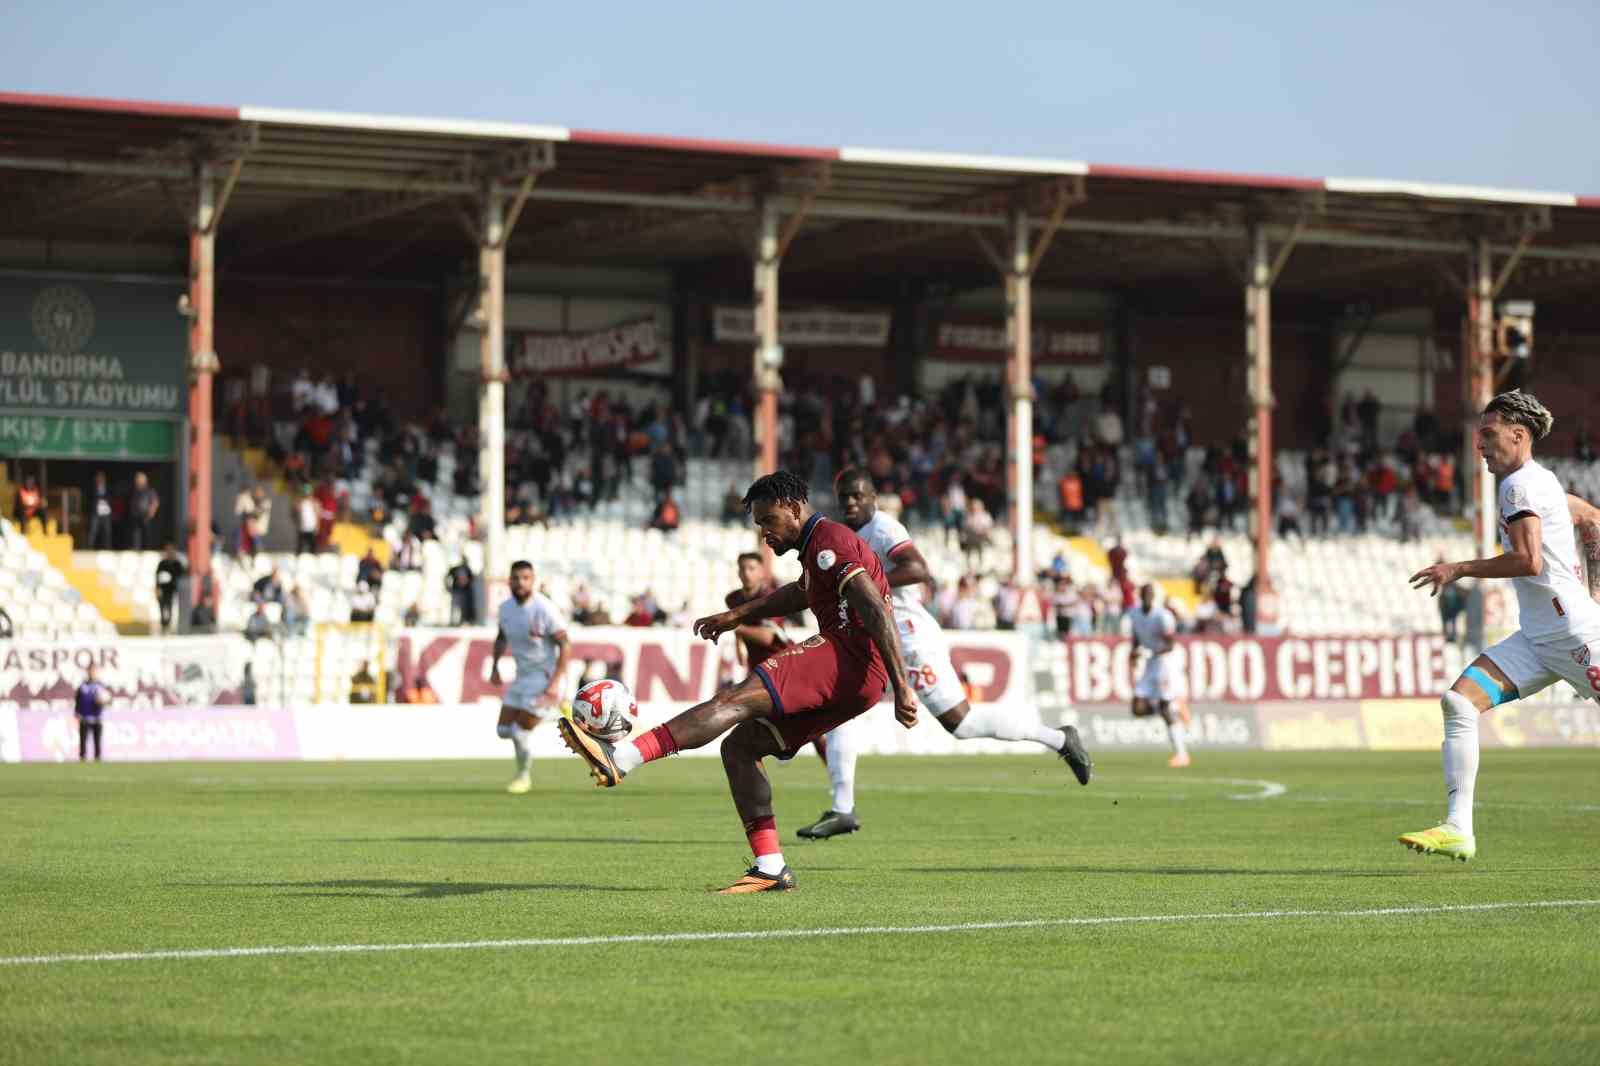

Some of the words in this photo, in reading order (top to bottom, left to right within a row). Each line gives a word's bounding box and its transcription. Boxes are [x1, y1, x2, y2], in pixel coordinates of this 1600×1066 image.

[55, 381, 178, 408] STADYUMU
[72, 419, 129, 442] EXIT
[1073, 639, 1267, 701] BODO
[1276, 635, 1449, 699] CEPHE
